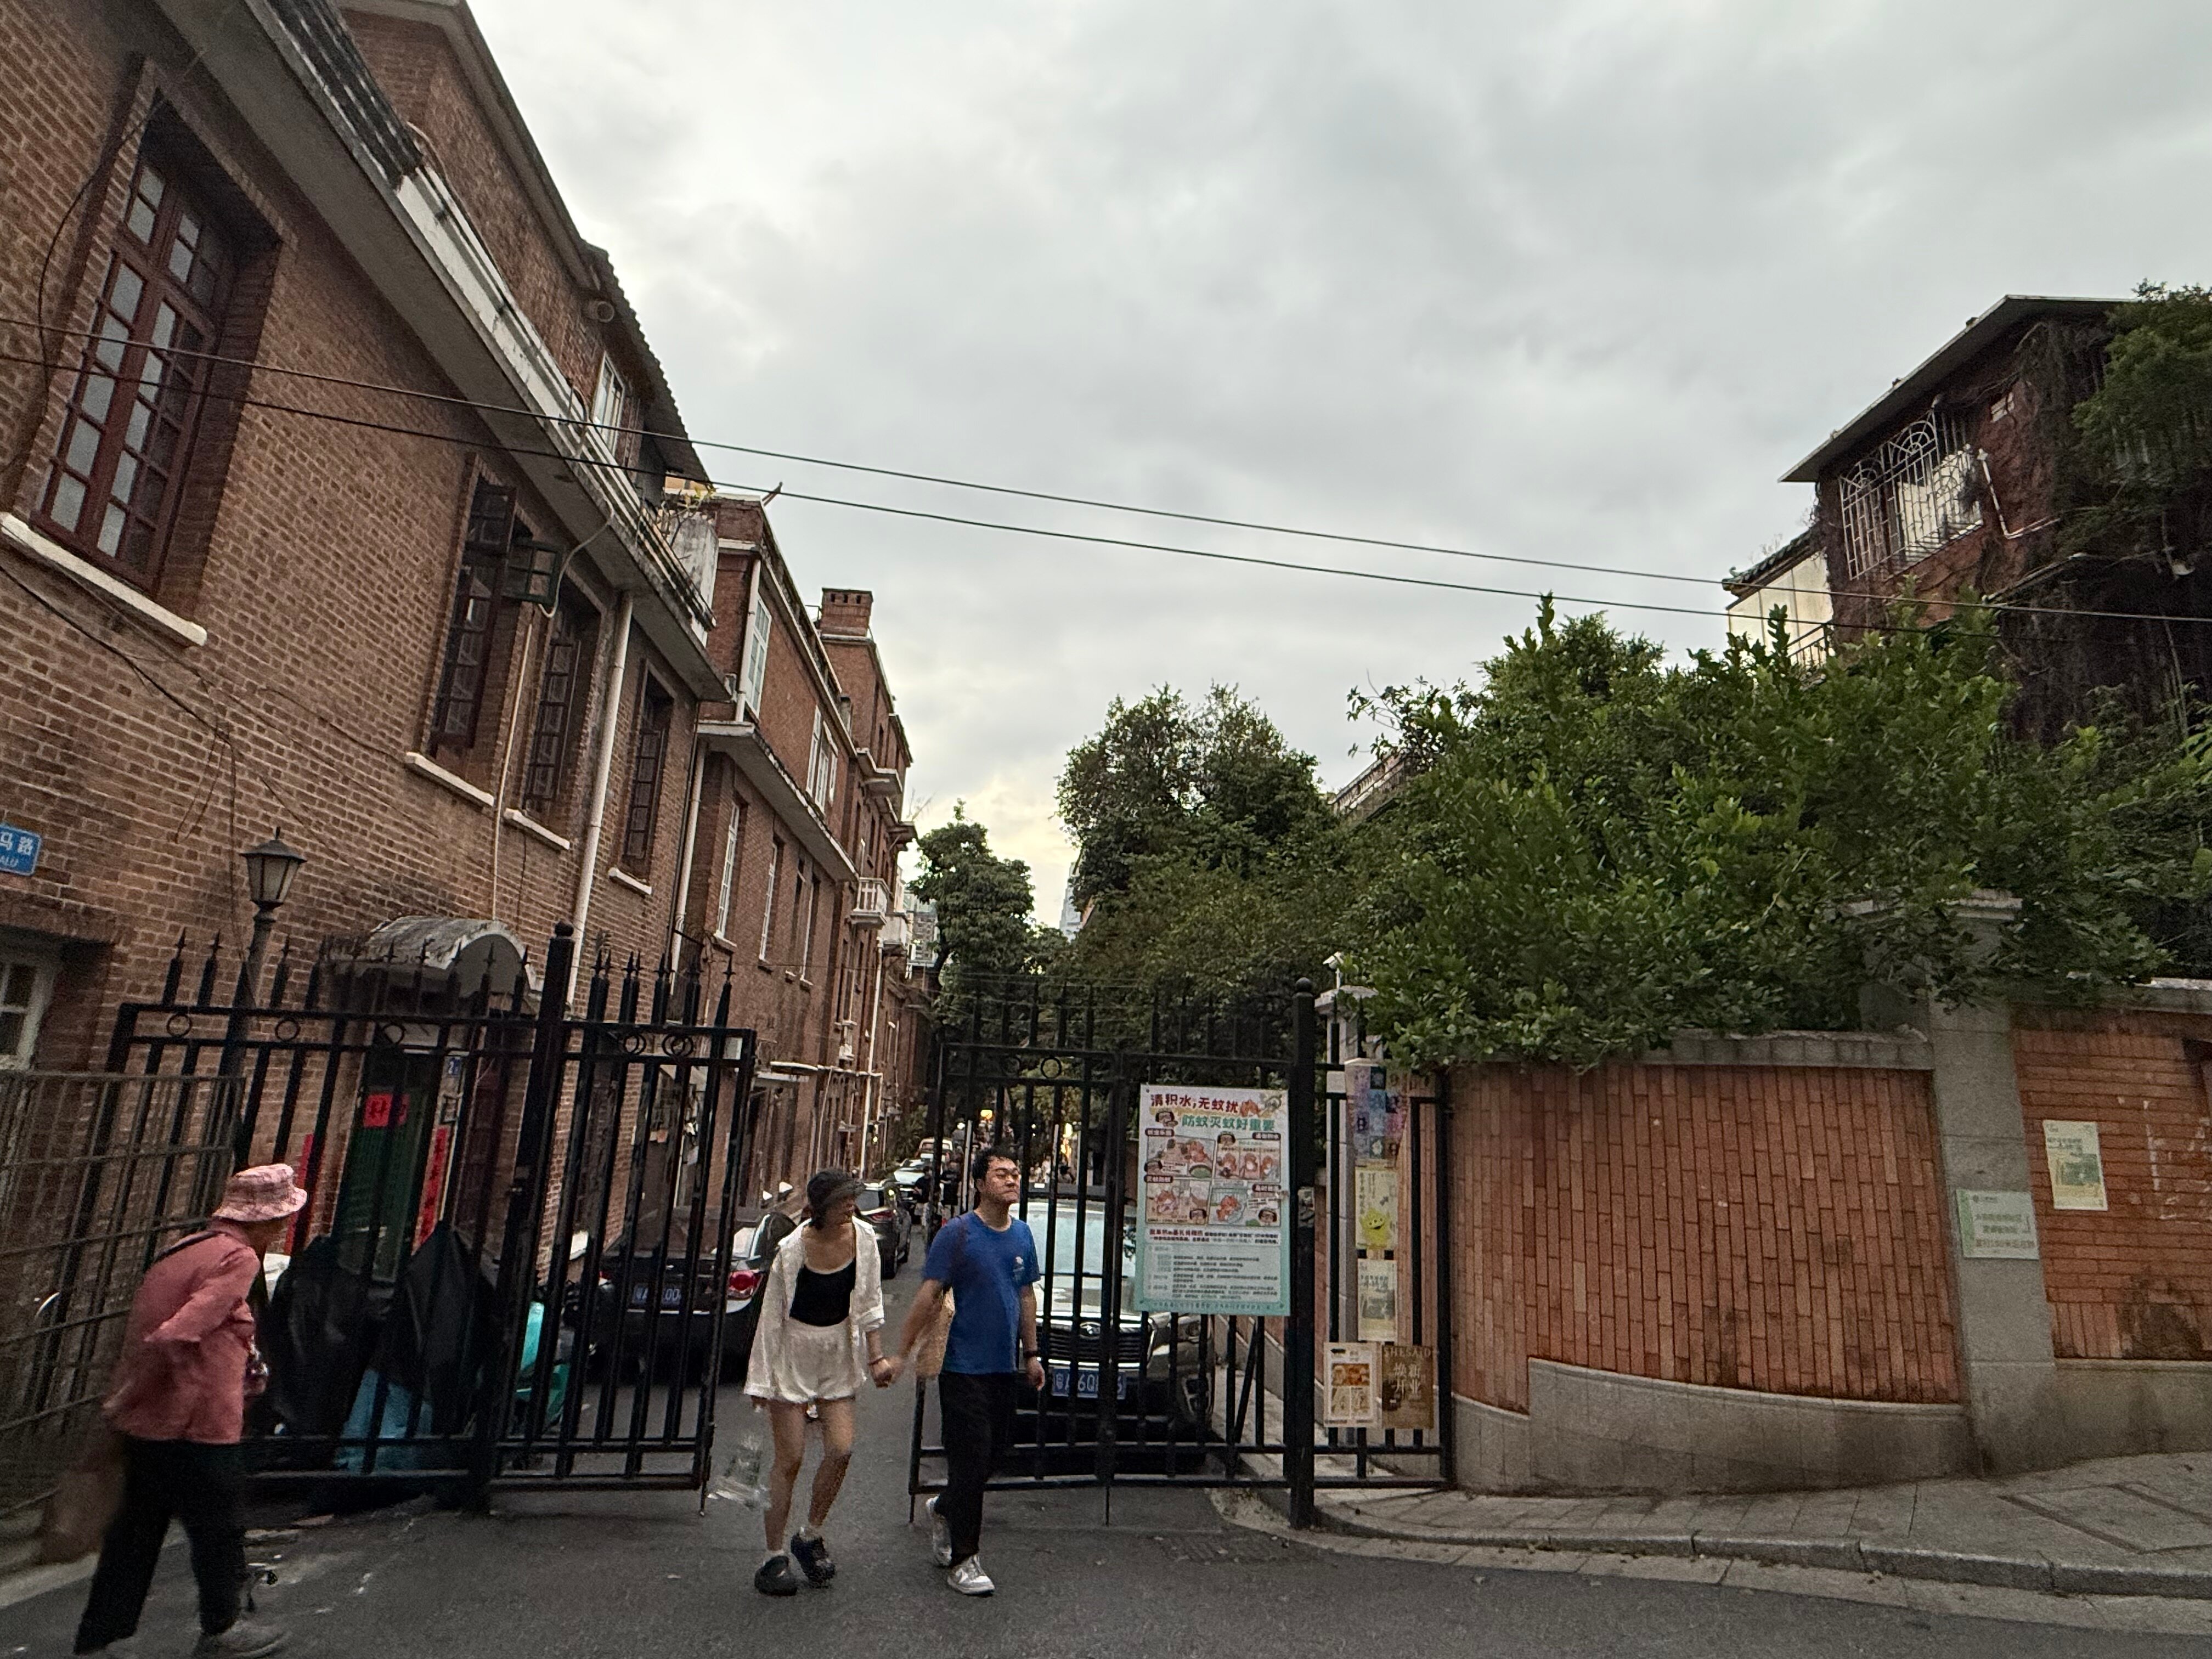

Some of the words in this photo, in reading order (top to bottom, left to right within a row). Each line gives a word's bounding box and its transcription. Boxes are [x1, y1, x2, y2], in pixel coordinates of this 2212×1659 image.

[1182, 1115, 1274, 1131] 防蚊灭蚊好重要
